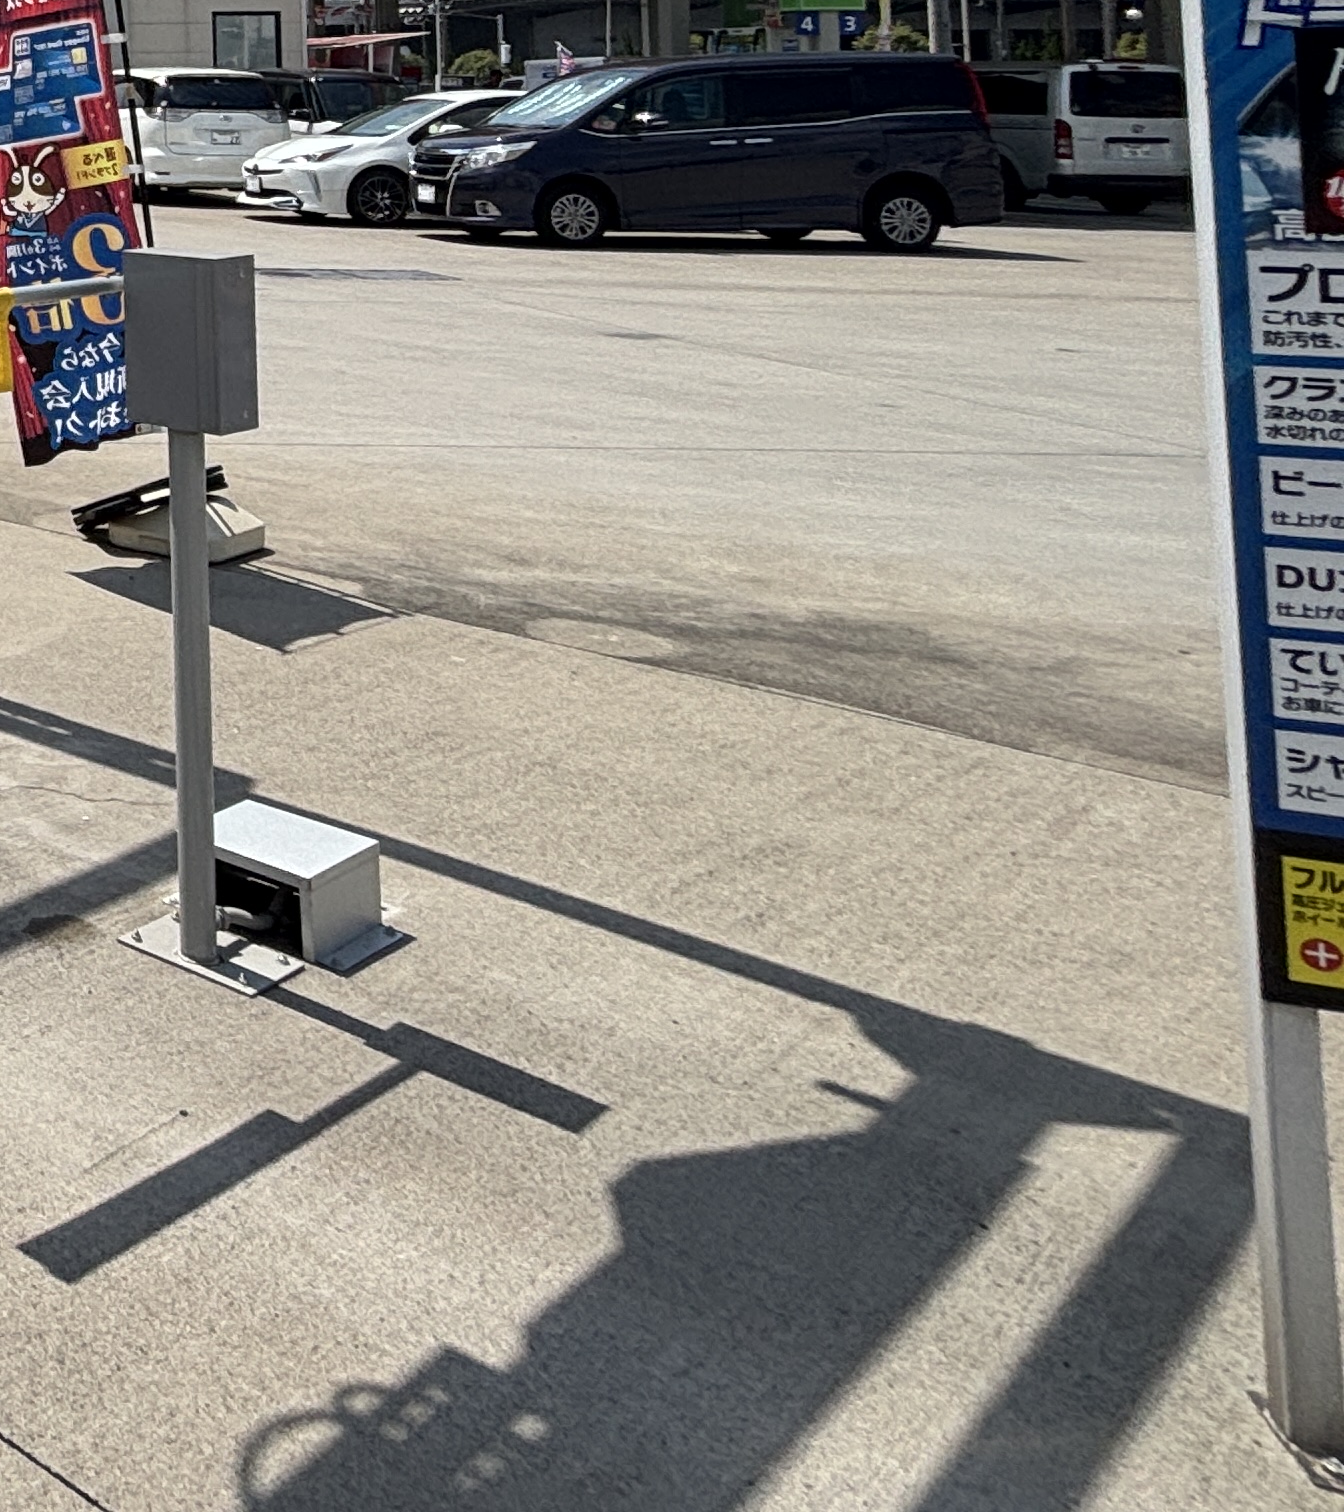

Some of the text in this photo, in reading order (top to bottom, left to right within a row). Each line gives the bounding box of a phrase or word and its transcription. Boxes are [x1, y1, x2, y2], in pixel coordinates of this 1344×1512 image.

[800, 18, 814, 32] 4
[844, 16, 857, 31] 3
[1263, 376, 1344, 403] クラ
[1276, 564, 1344, 593] DU
[1280, 676, 1344, 696] コーテ
